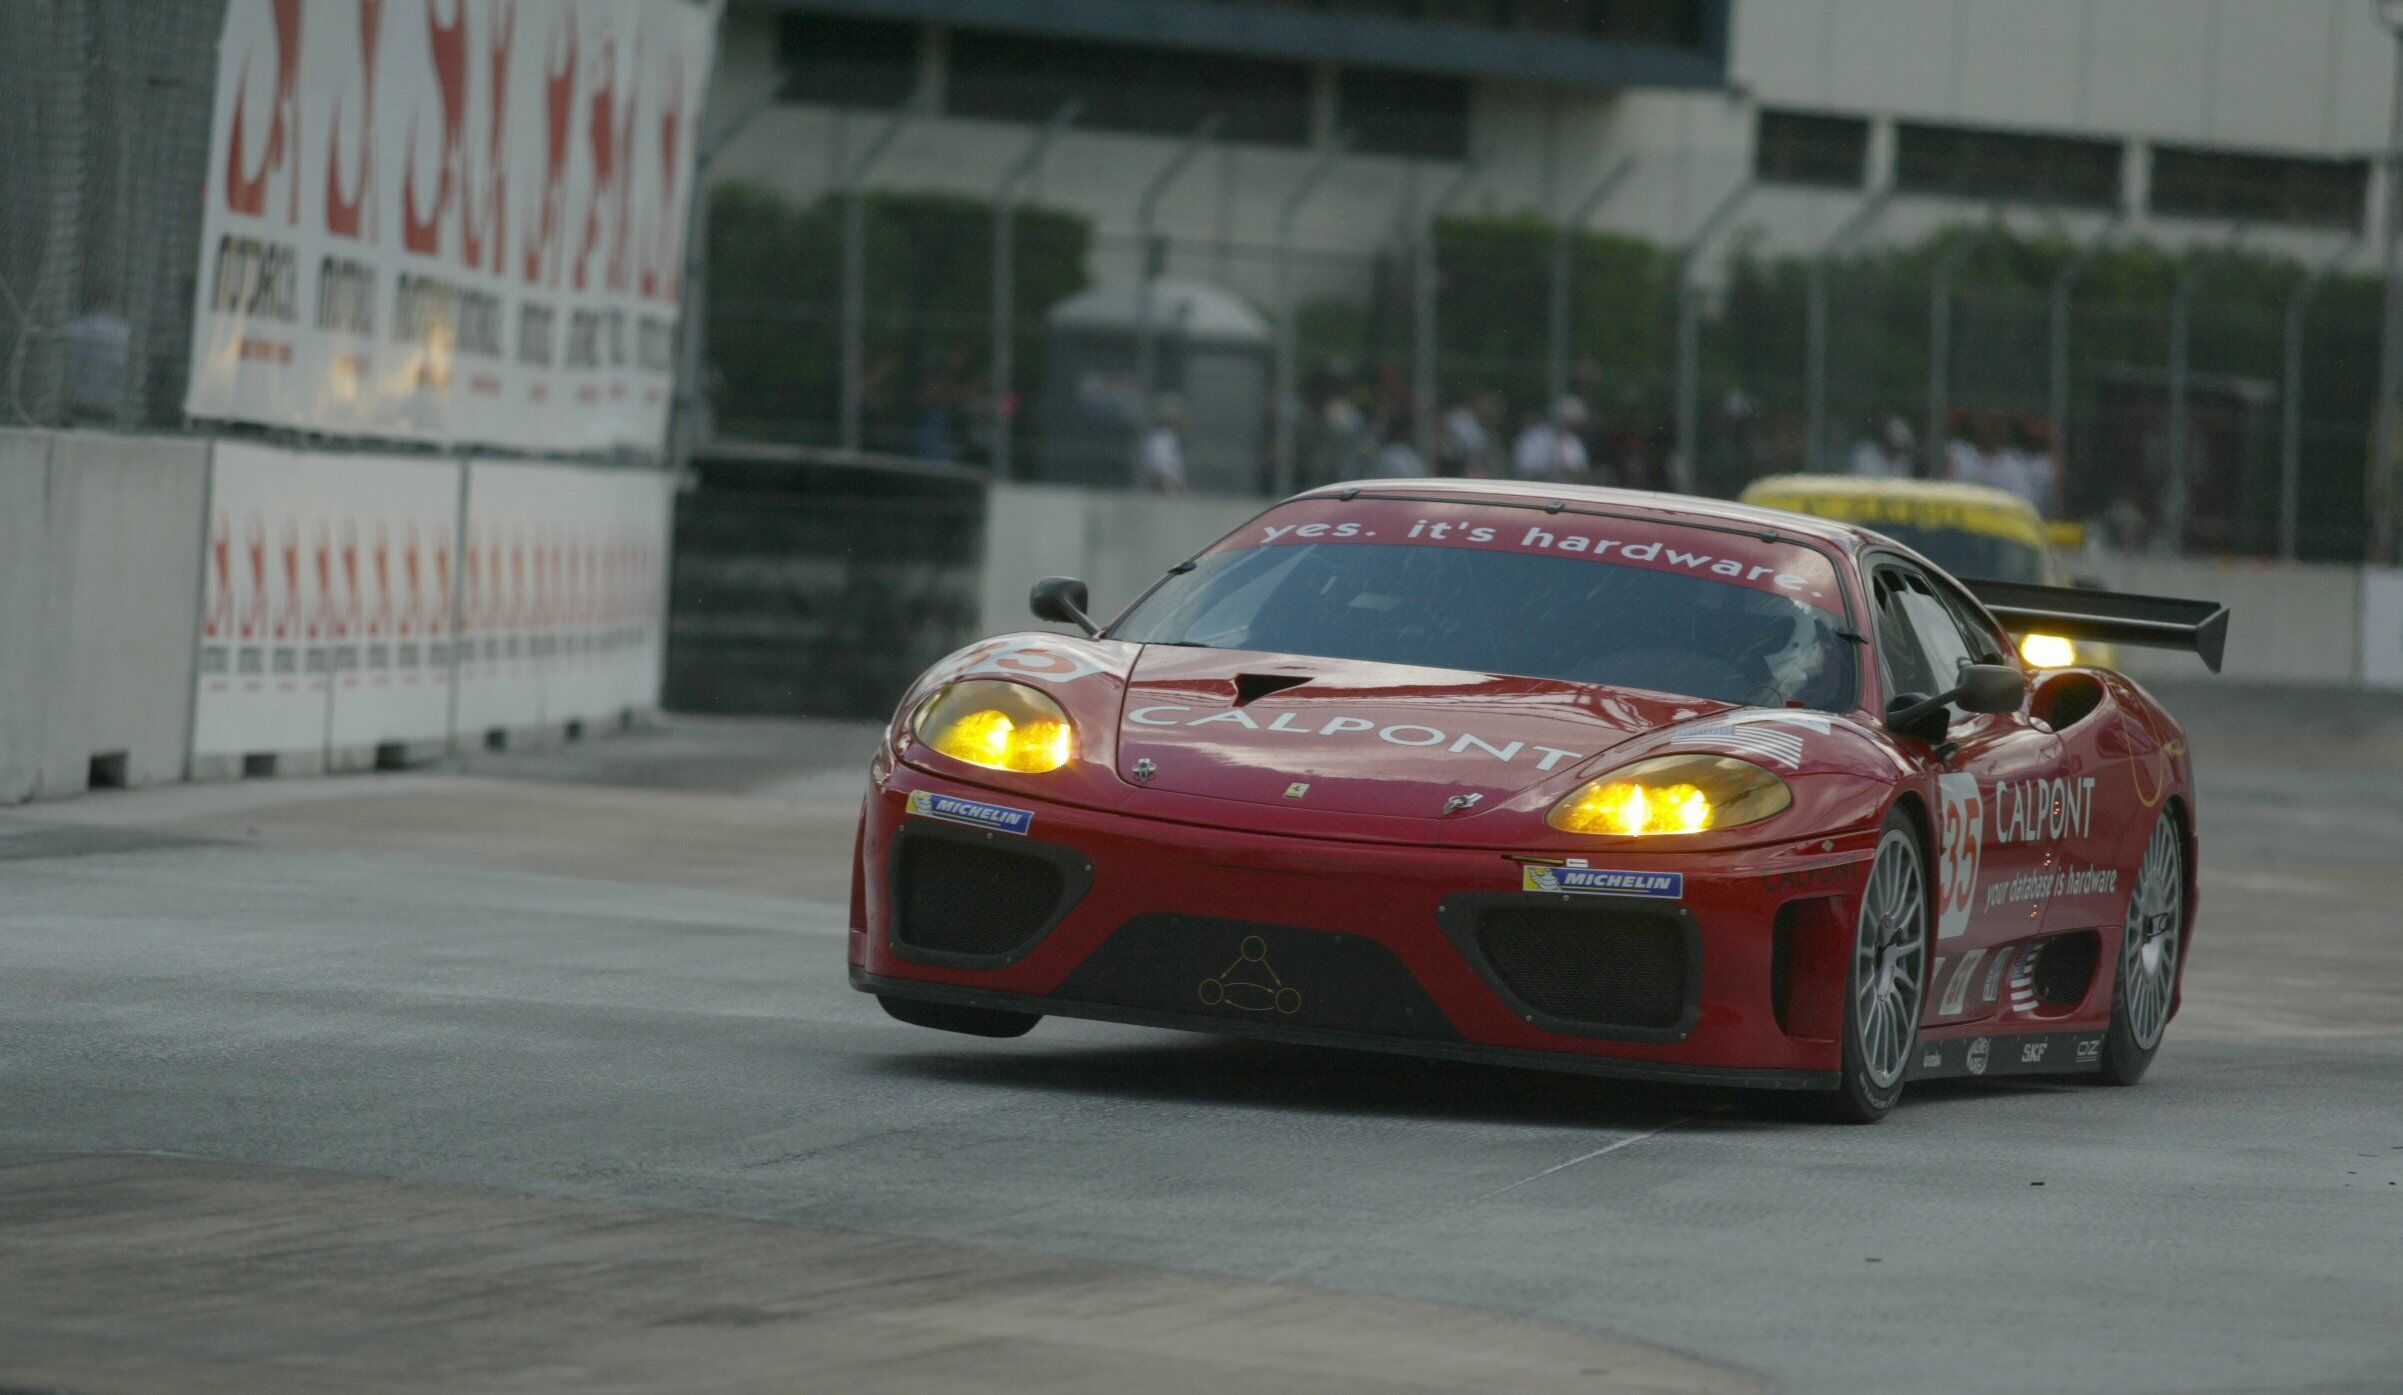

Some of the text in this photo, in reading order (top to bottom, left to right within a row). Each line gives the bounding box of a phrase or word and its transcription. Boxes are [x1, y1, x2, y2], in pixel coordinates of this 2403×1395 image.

[1260, 519, 1823, 598] yes. it's hardware.
[1127, 705, 1585, 772] CALPONT
[935, 799, 1022, 825] MICHELIN
[1996, 777, 2095, 843] CALPONT
[1564, 872, 1672, 890] MICHELIN
[1984, 863, 2118, 914] your database is hardware
[2021, 1043, 2048, 1062] SKF
